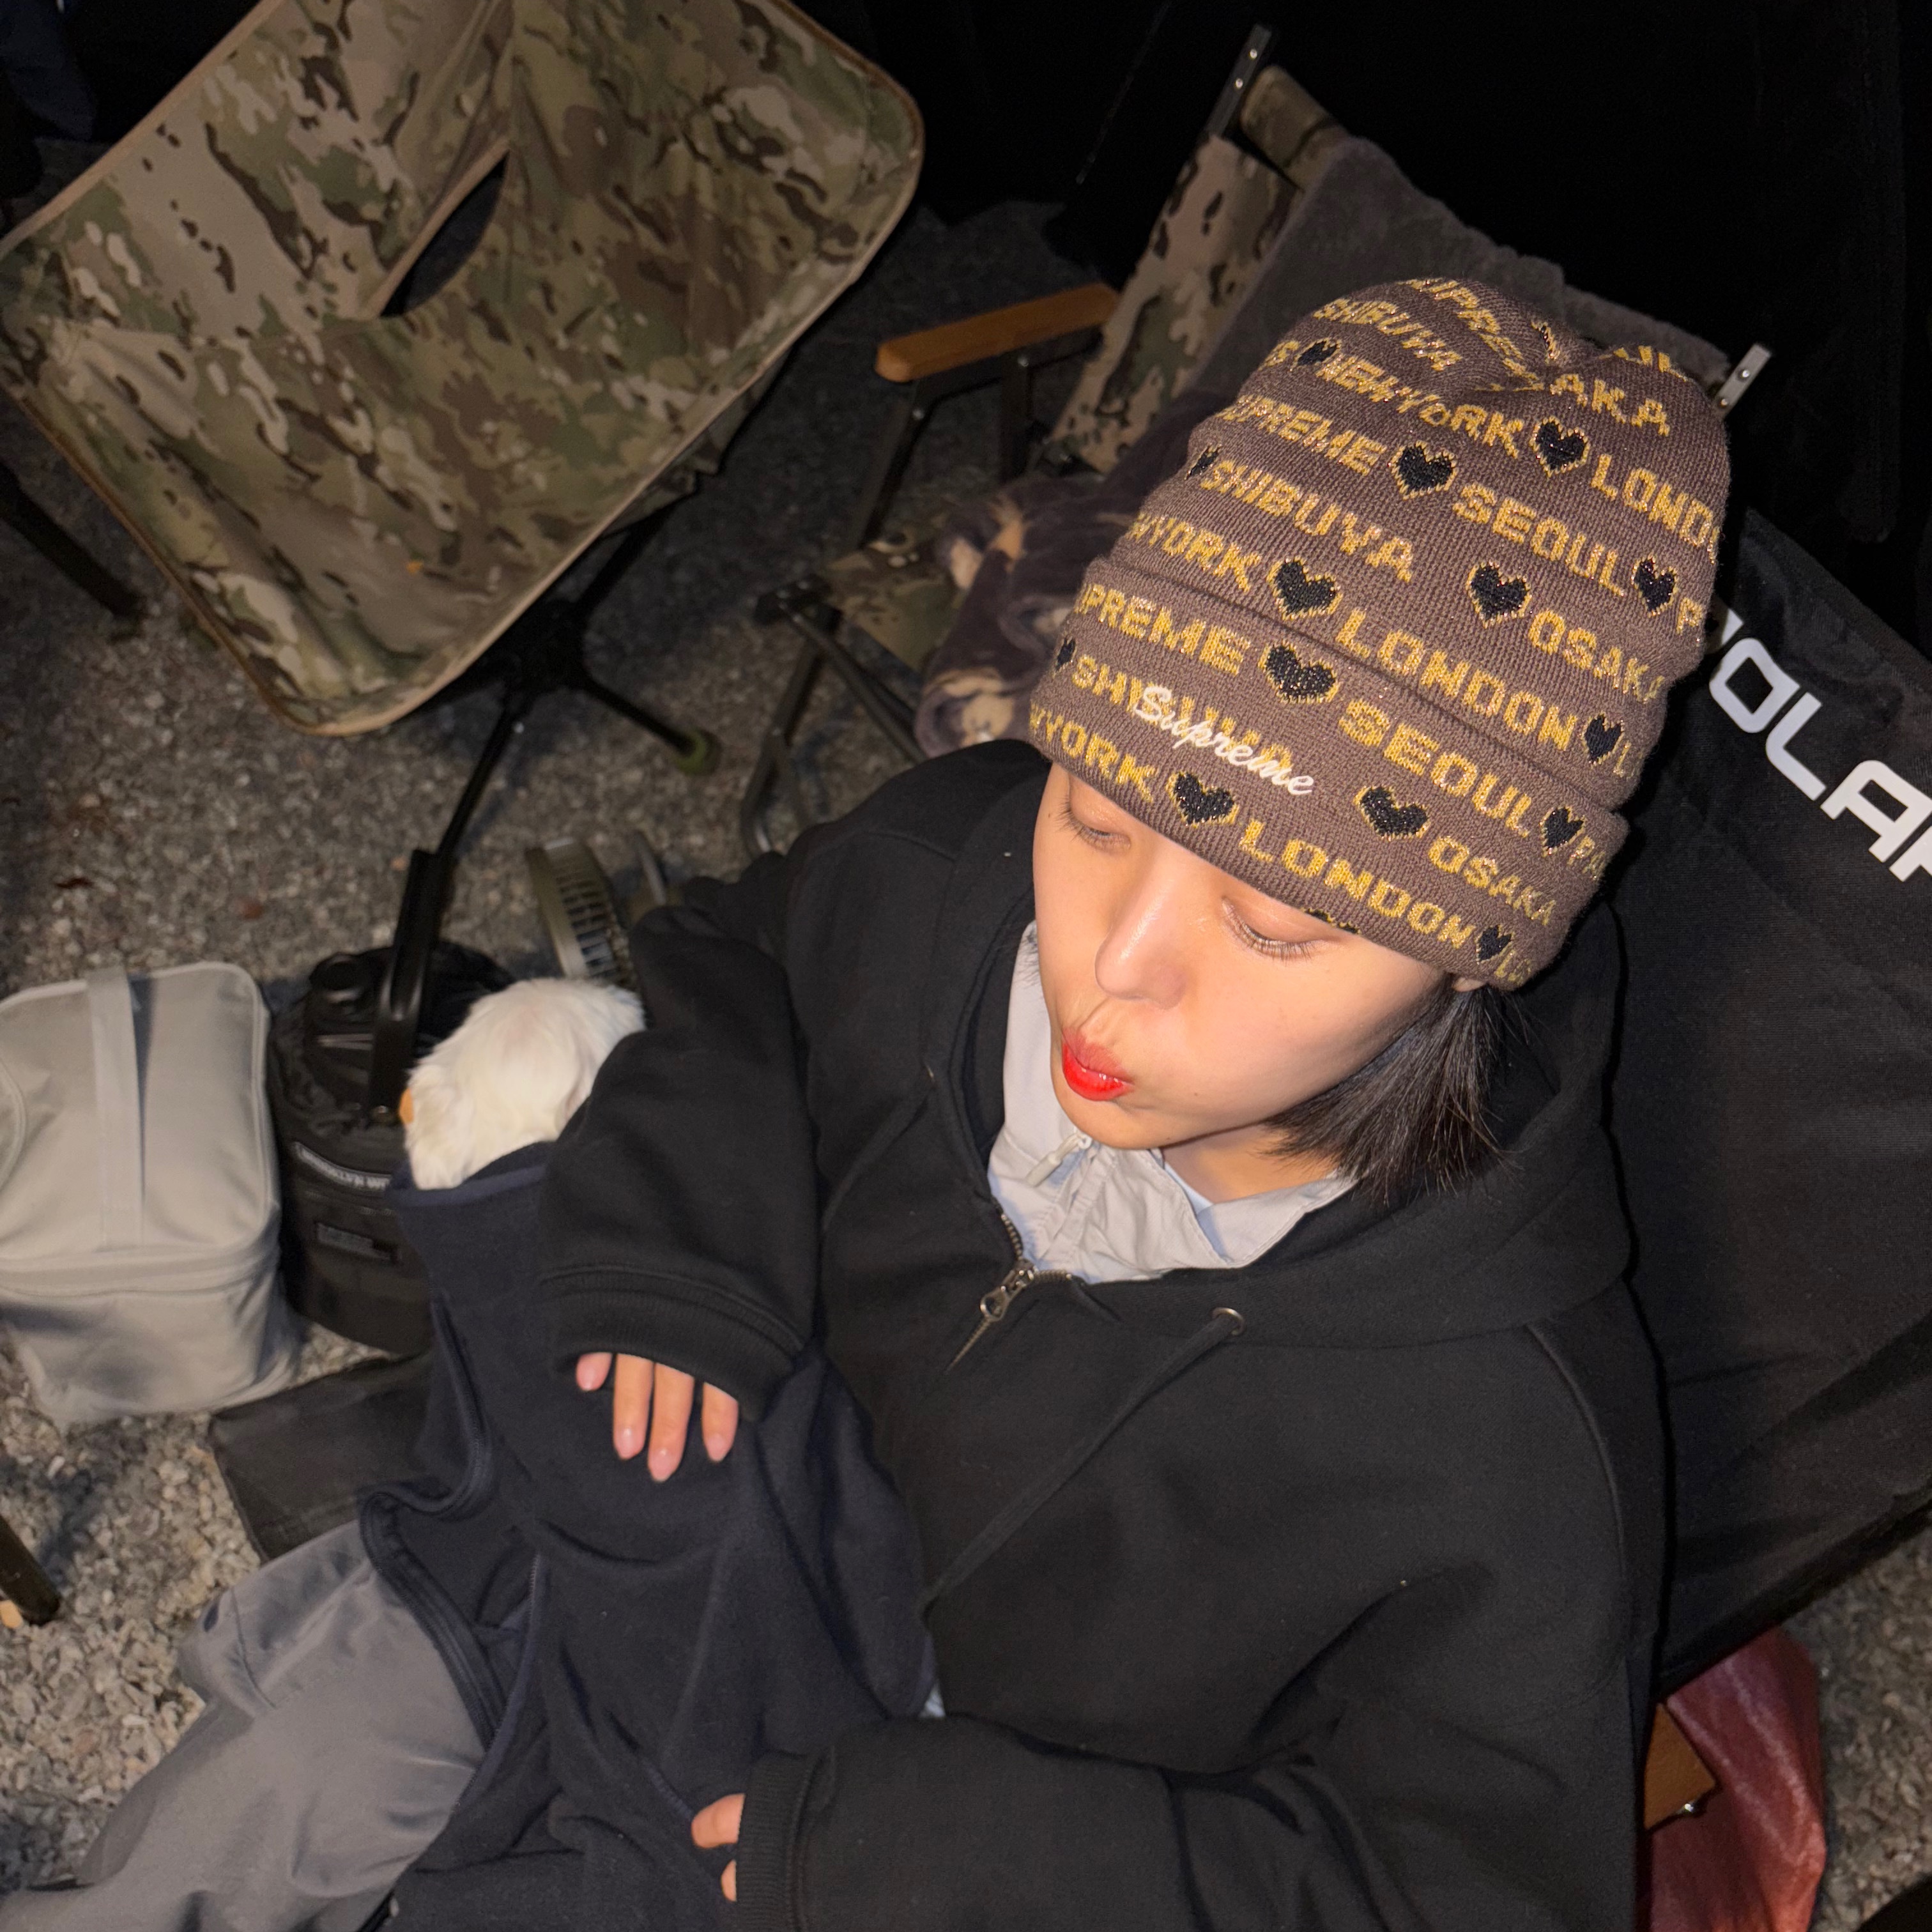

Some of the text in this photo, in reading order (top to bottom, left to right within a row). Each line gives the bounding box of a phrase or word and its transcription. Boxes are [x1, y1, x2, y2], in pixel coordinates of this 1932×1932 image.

[1200, 459, 1412, 583] SHIBUYA
[1452, 482, 1625, 598] SEOUL
[1134, 686, 1314, 795] Supreme
[1335, 609, 1578, 752] LONDON
[1339, 699, 1531, 838] SEOUL
[1239, 818, 1475, 949] LONDON
[1428, 835, 1557, 926] OSAKA
